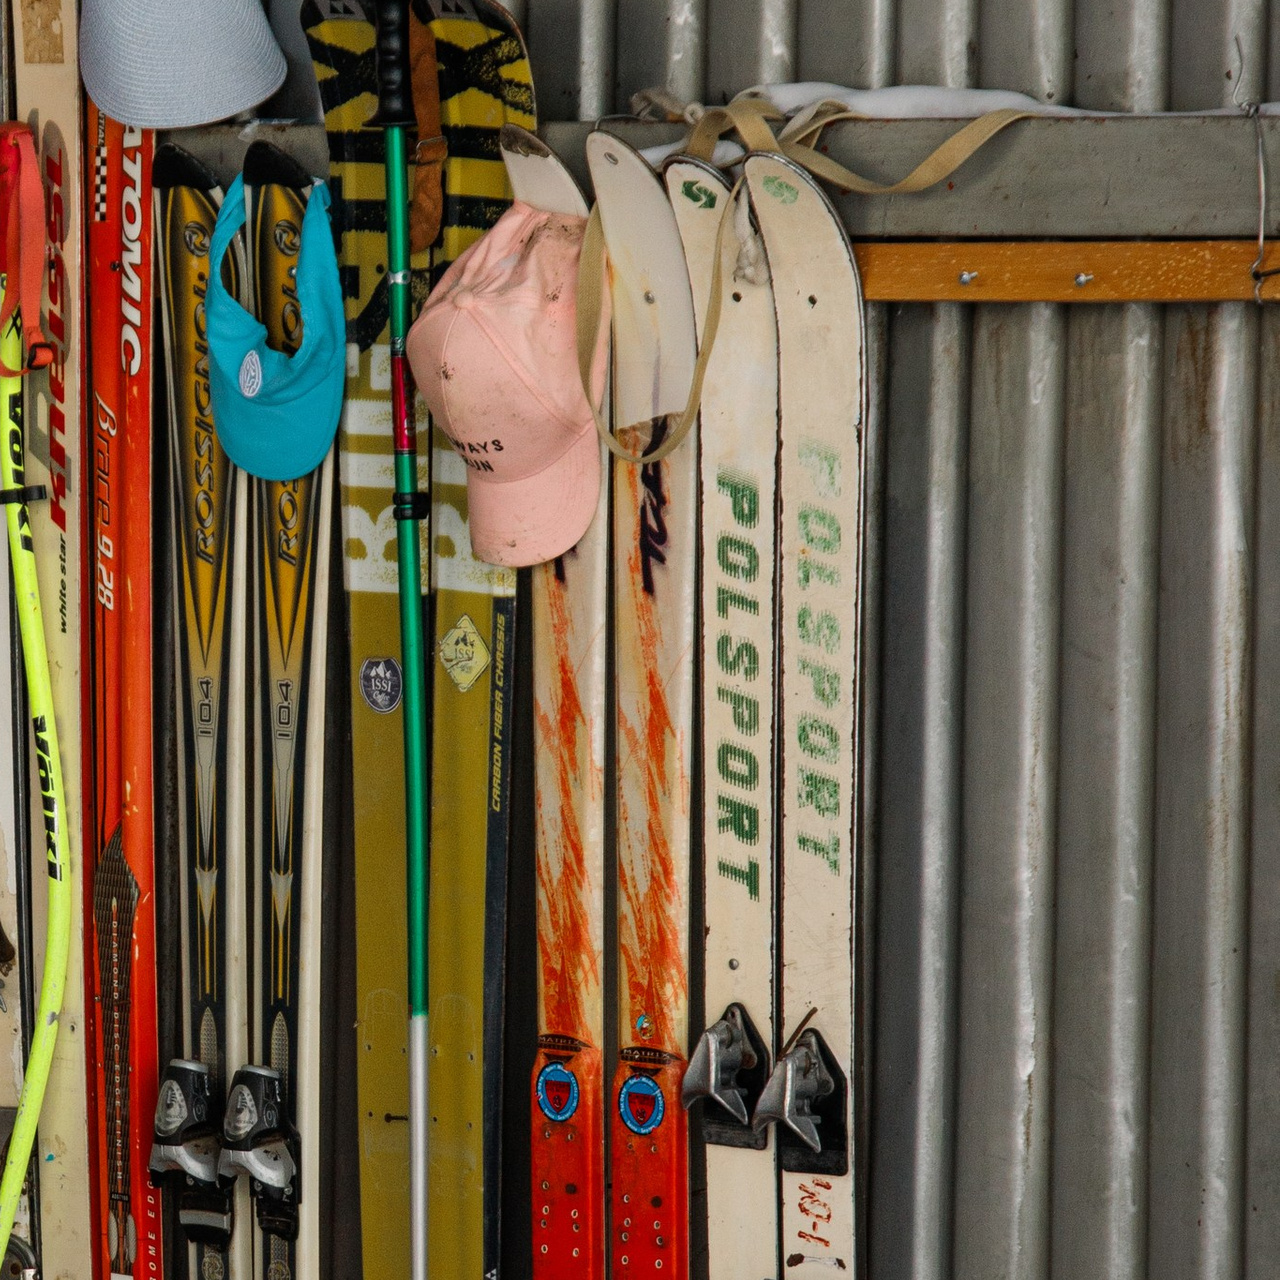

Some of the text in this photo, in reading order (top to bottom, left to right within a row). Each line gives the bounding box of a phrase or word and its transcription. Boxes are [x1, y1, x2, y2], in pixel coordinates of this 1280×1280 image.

[121, 125, 142, 377] ATOMIC
[447, 438, 504, 454] WAYS
[57, 534, 69, 634] white star
[97, 535, 115, 611] 9.28
[198, 677, 214, 737] 10.4
[276, 679, 293, 739] 10.4
[370, 678, 391, 692] ISSI
[492, 613, 506, 813] CARBON FIBER CHASSIS
[716, 462, 760, 901] POLSPORT
[112, 920, 123, 1180] DIAMOND DISC EDGE FINISH
[623, 1049, 671, 1060] MATRIX
